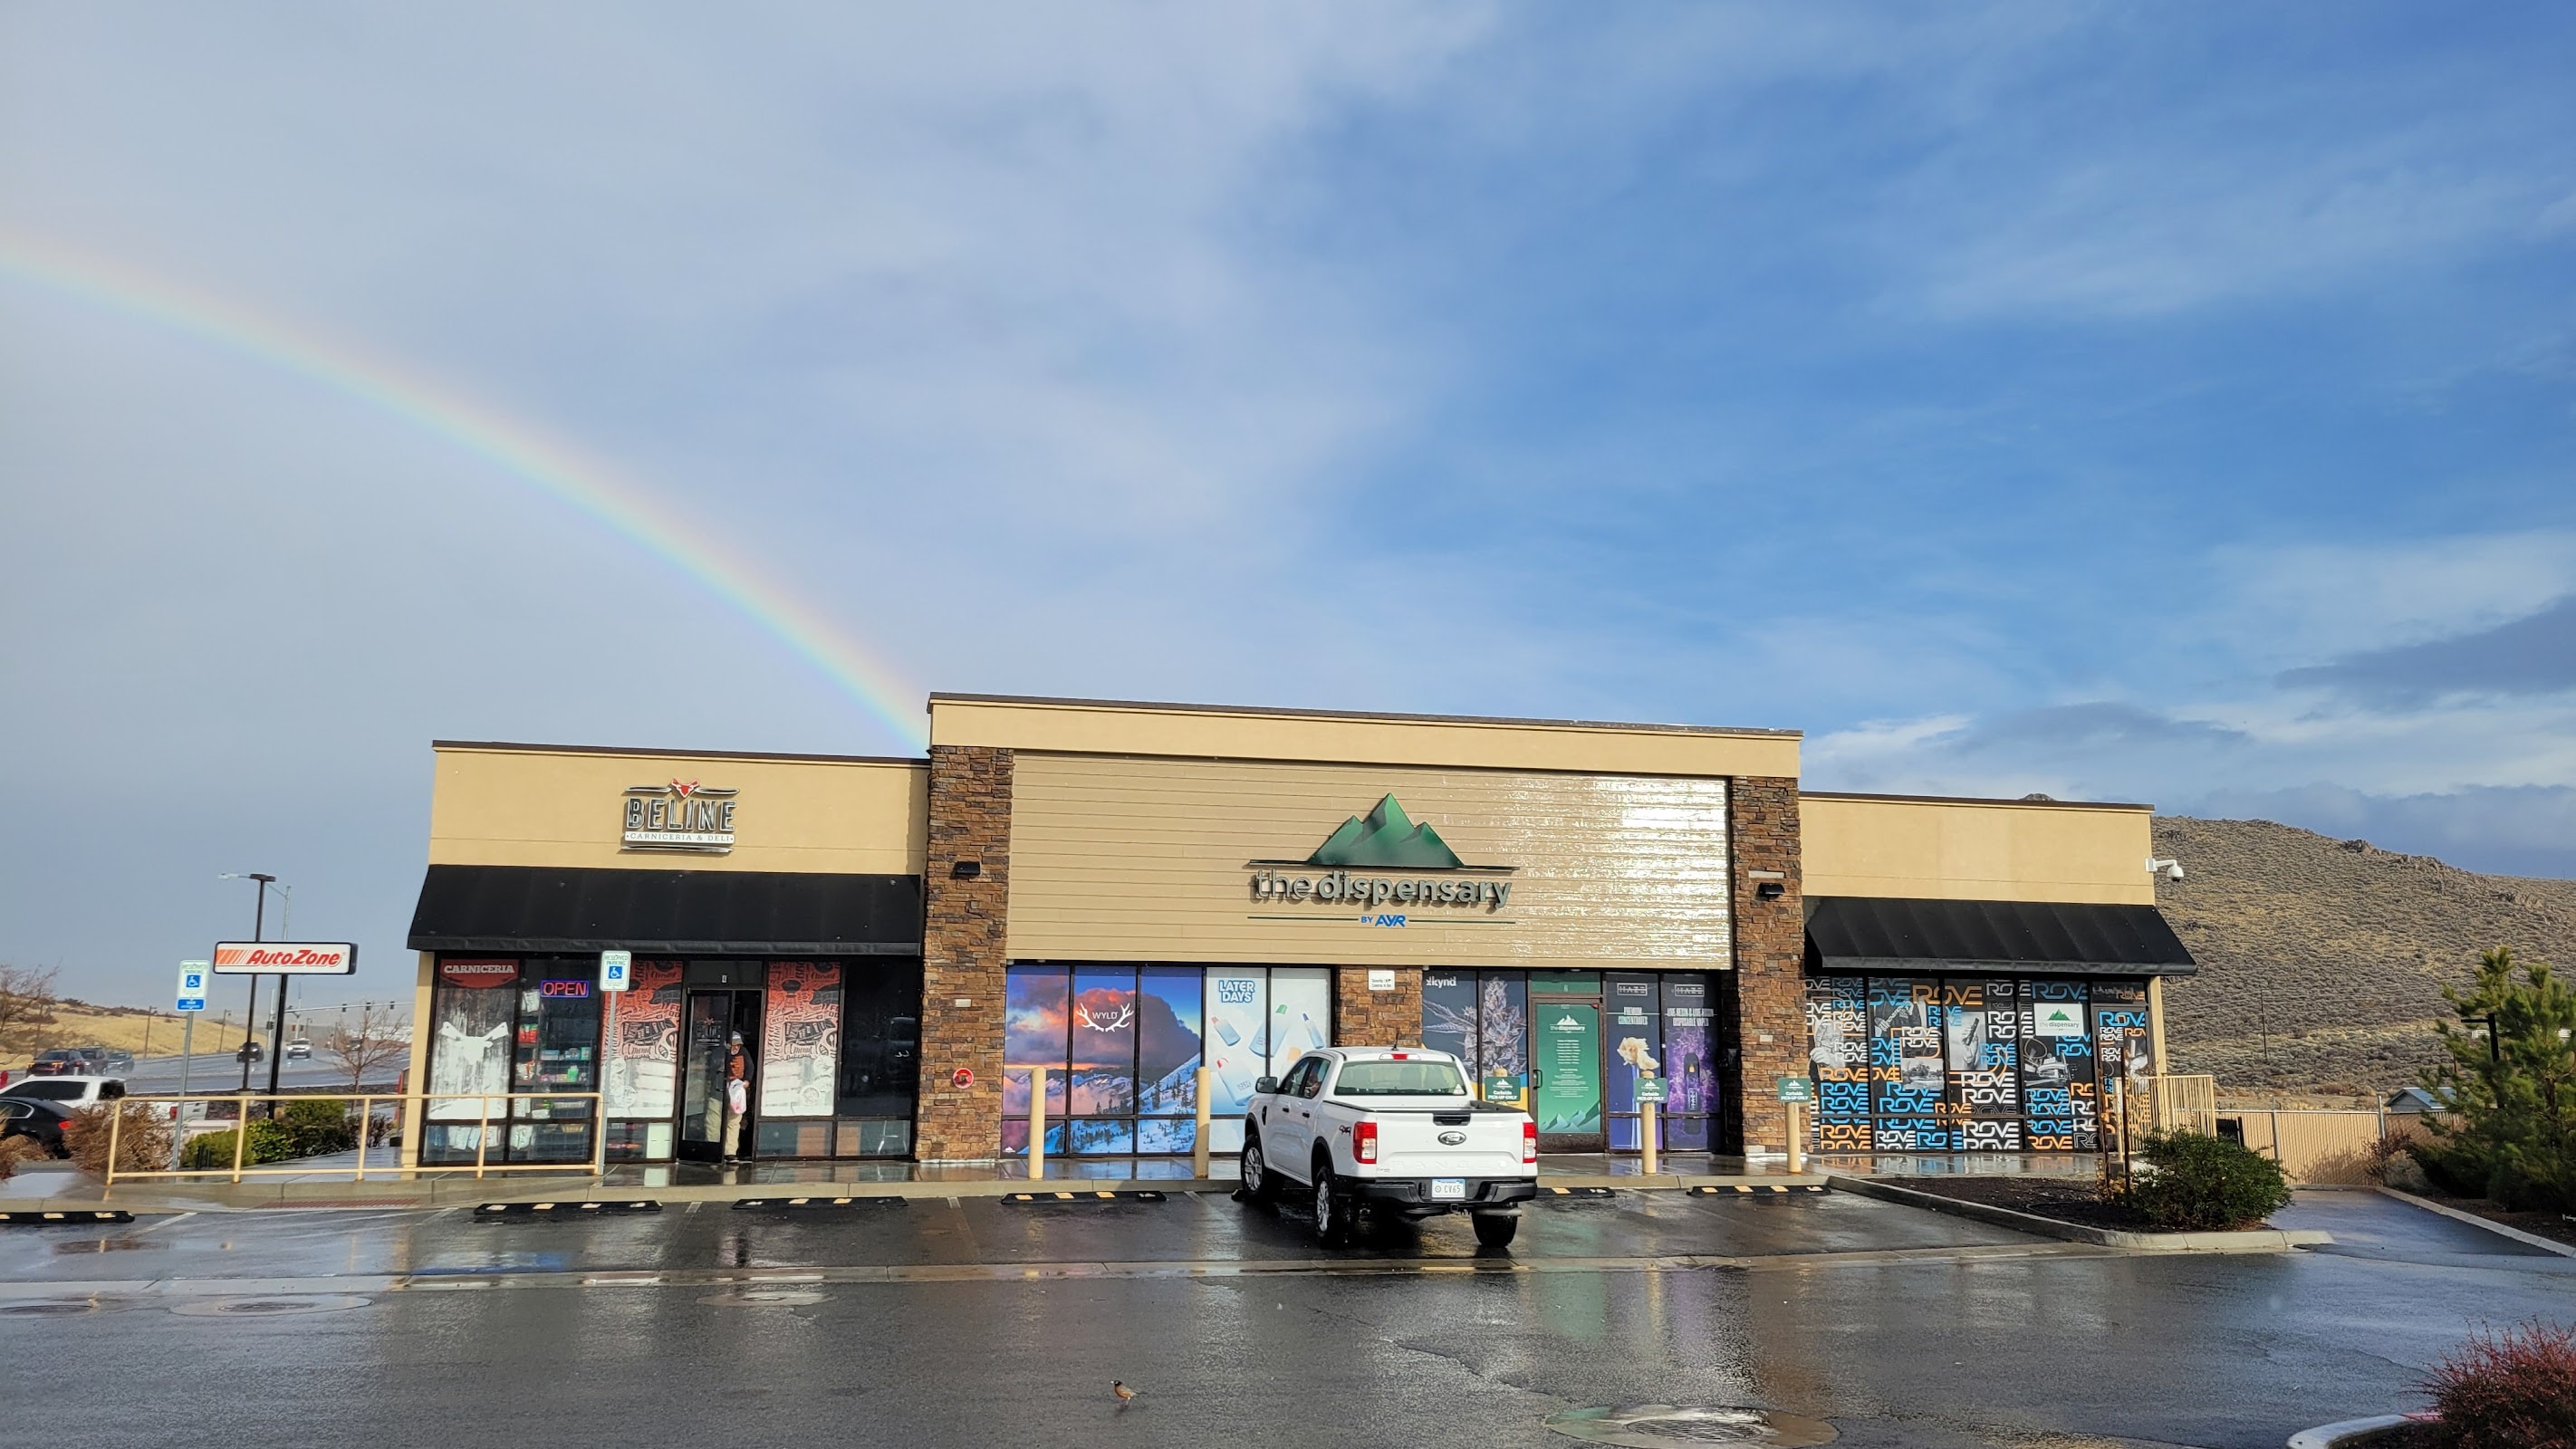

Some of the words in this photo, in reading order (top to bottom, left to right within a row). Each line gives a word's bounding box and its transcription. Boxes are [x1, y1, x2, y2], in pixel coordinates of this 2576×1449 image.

[627, 797, 736, 830] BELINE
[1256, 868, 1312, 898] the
[1318, 870, 1513, 907] dispensary
[1360, 916, 1373, 924] BY
[1375, 915, 1407, 927] AYR
[246, 949, 341, 966] AutoZone
[443, 964, 515, 974] CARNICERIA
[543, 982, 587, 996] OPEN
[1219, 980, 1255, 993] LATER
[2032, 983, 2089, 1000] ROVE
[1221, 991, 1254, 1003] DAYS
[1806, 1003, 1831, 1014] OVE
[1833, 1000, 1865, 1009] ROVE
[1091, 1012, 1117, 1020] WYLD
[1833, 1012, 1866, 1022] ROVE
[1834, 1022, 1867, 1032] ROVE
[1902, 1026, 1939, 1037] ROVE
[1835, 1042, 1868, 1052] ROVE
[1871, 1038, 1901, 1051] OVE
[1903, 1038, 1939, 1048] ROVE
[1980, 1043, 2015, 1054] ROVE
[2055, 1042, 2092, 1057] ROV
[1835, 1052, 1868, 1062] ROVE
[2100, 1047, 2121, 1056] ROV
[1872, 1052, 1901, 1065] OVE
[1981, 1055, 2016, 1065] ROVE
[1820, 1068, 1869, 1082] ROVE
[1961, 1071, 2015, 1088] ROVE
[1821, 1082, 1869, 1097] ROVE
[2024, 1089, 2069, 1102] ROVE
[1961, 1089, 2016, 1104] ROVE
[1821, 1097, 1870, 1110] ROVE
[1879, 1098, 1934, 1112] ROVE
[2025, 1103, 2071, 1115] ROVE
[1820, 1125, 1872, 1138] ROVE
[1962, 1121, 2020, 1137] ROVE
[2026, 1119, 2072, 1134] ROVE
[1875, 1130, 1917, 1143] ROVE
[2027, 1136, 2073, 1150] ROVE
